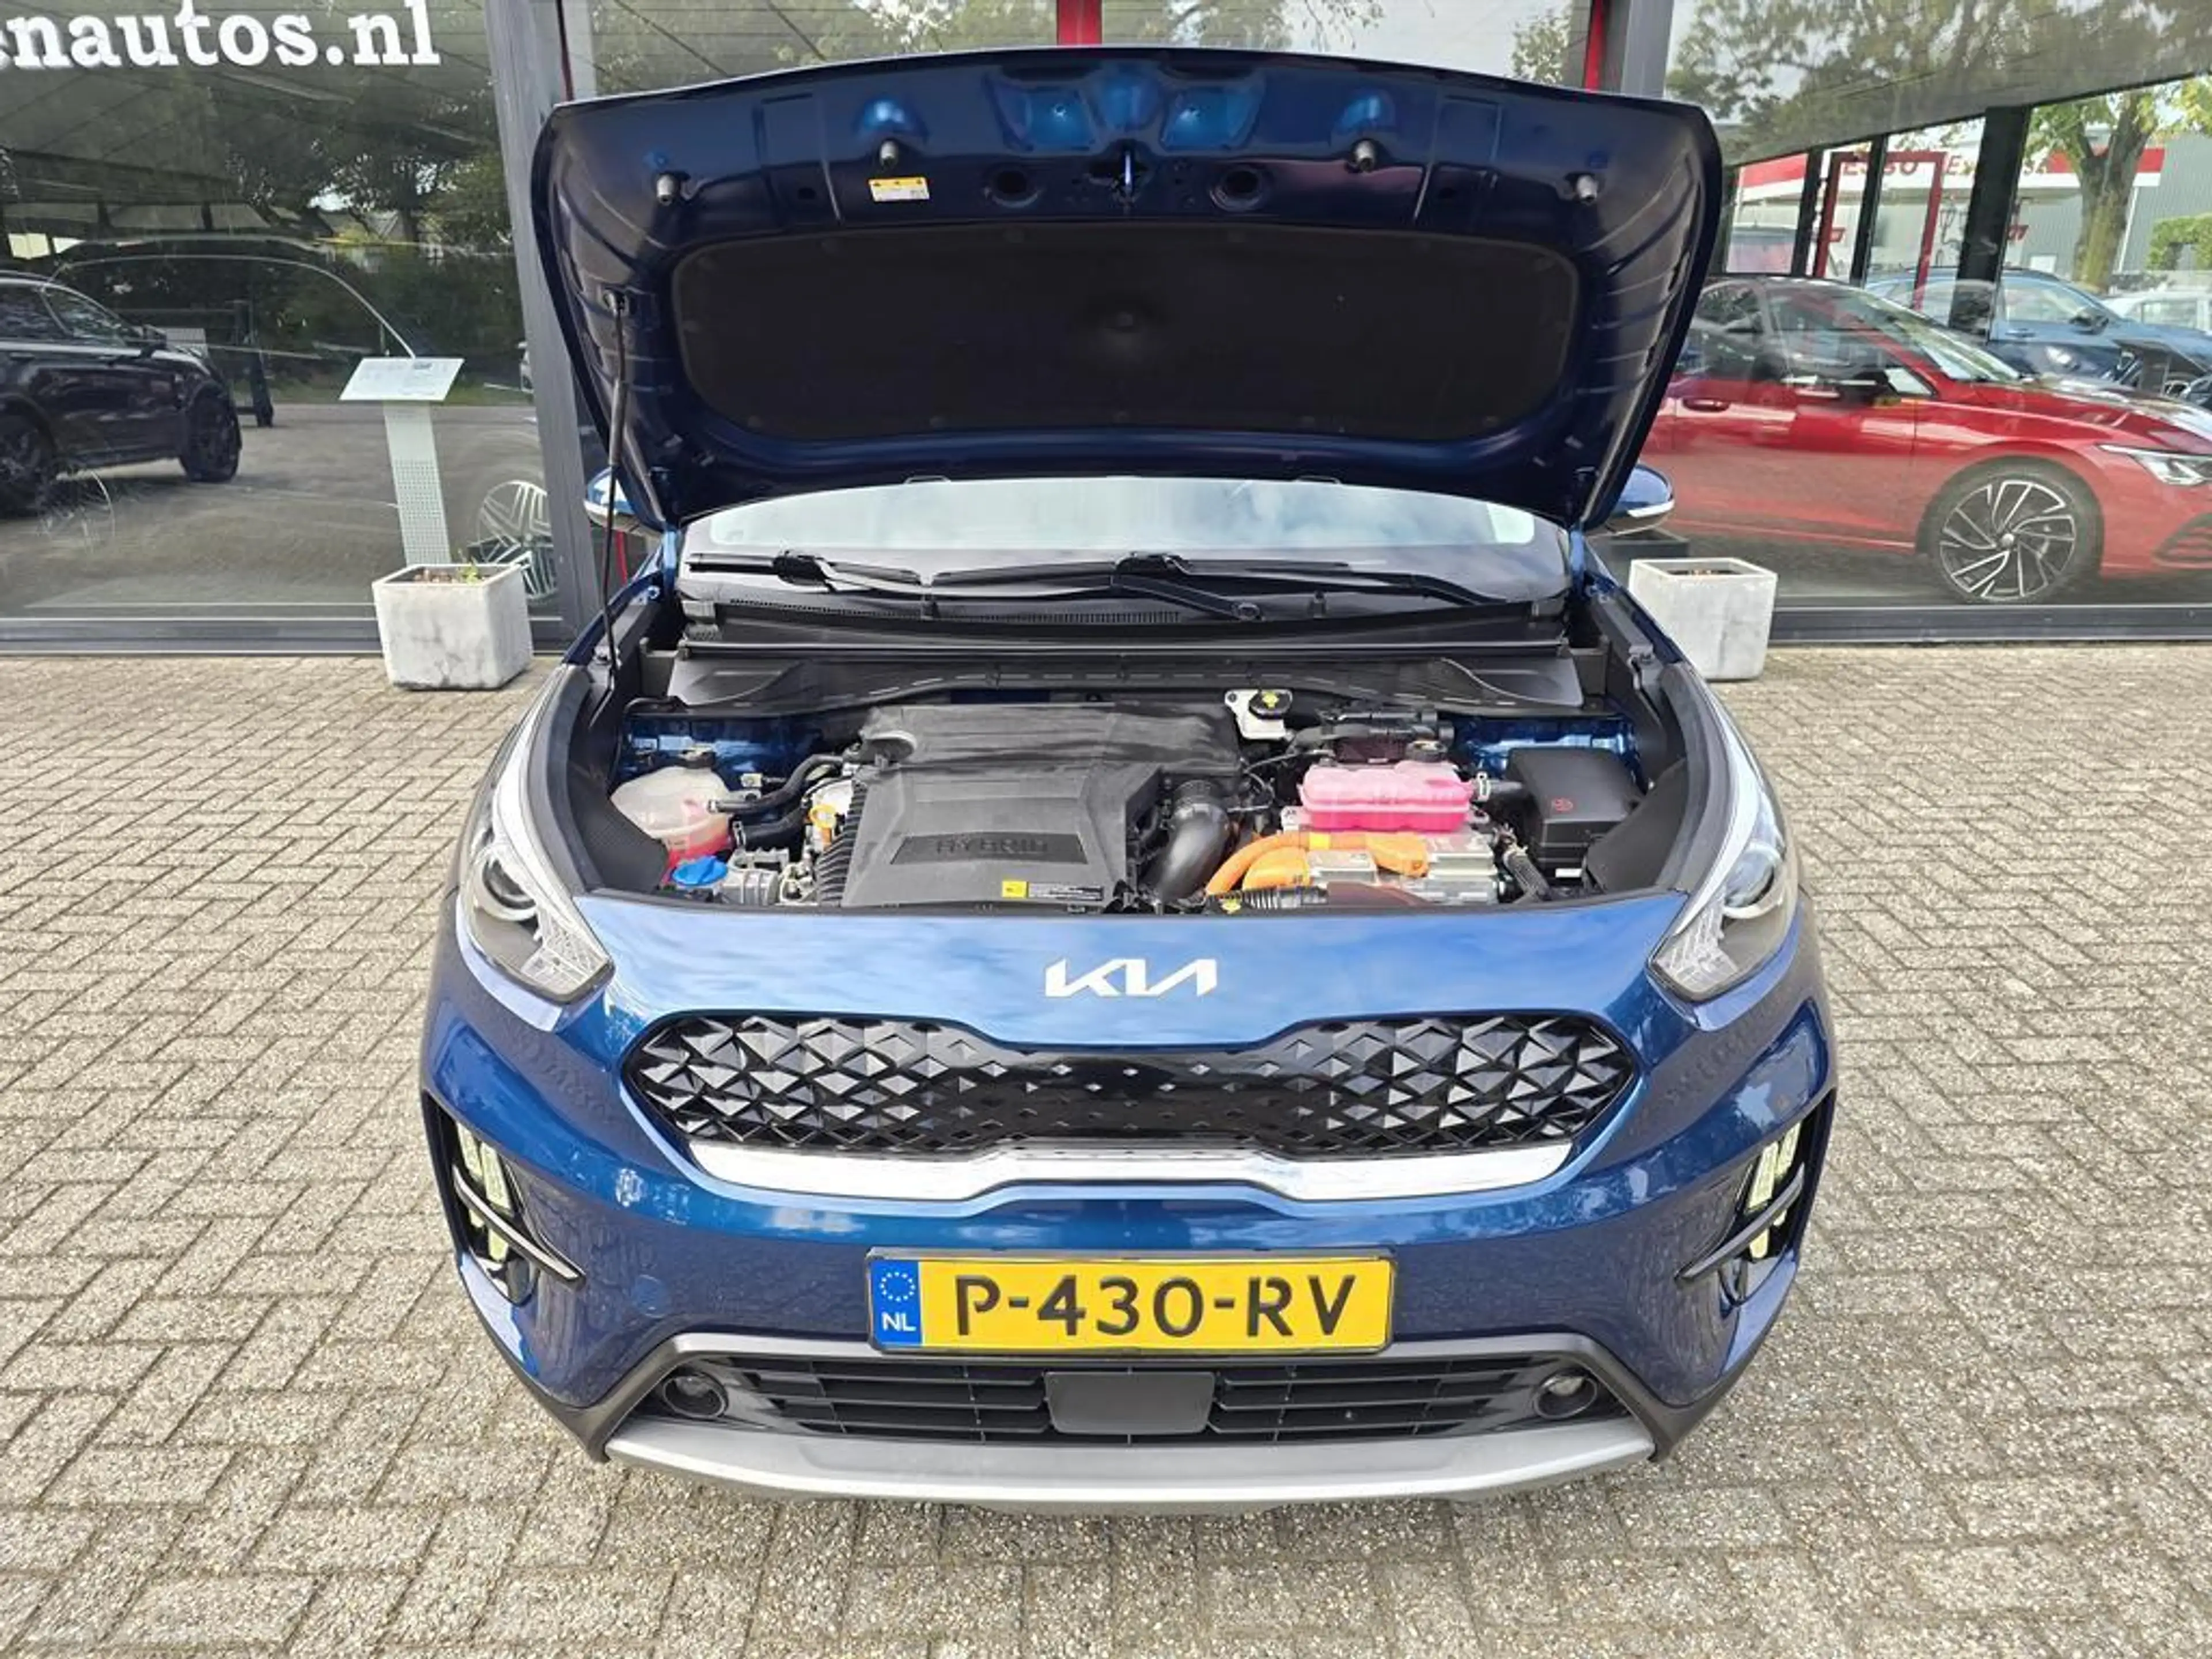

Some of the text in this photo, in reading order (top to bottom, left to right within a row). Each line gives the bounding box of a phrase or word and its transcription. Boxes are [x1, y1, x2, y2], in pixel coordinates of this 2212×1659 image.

[0, 0, 441, 68] nautos.nl
[937, 837, 1048, 854] HYBRID
[1046, 959, 1217, 997] KIA
[881, 1312, 917, 1332] NL
[955, 1274, 1356, 1338] P-430-RV
